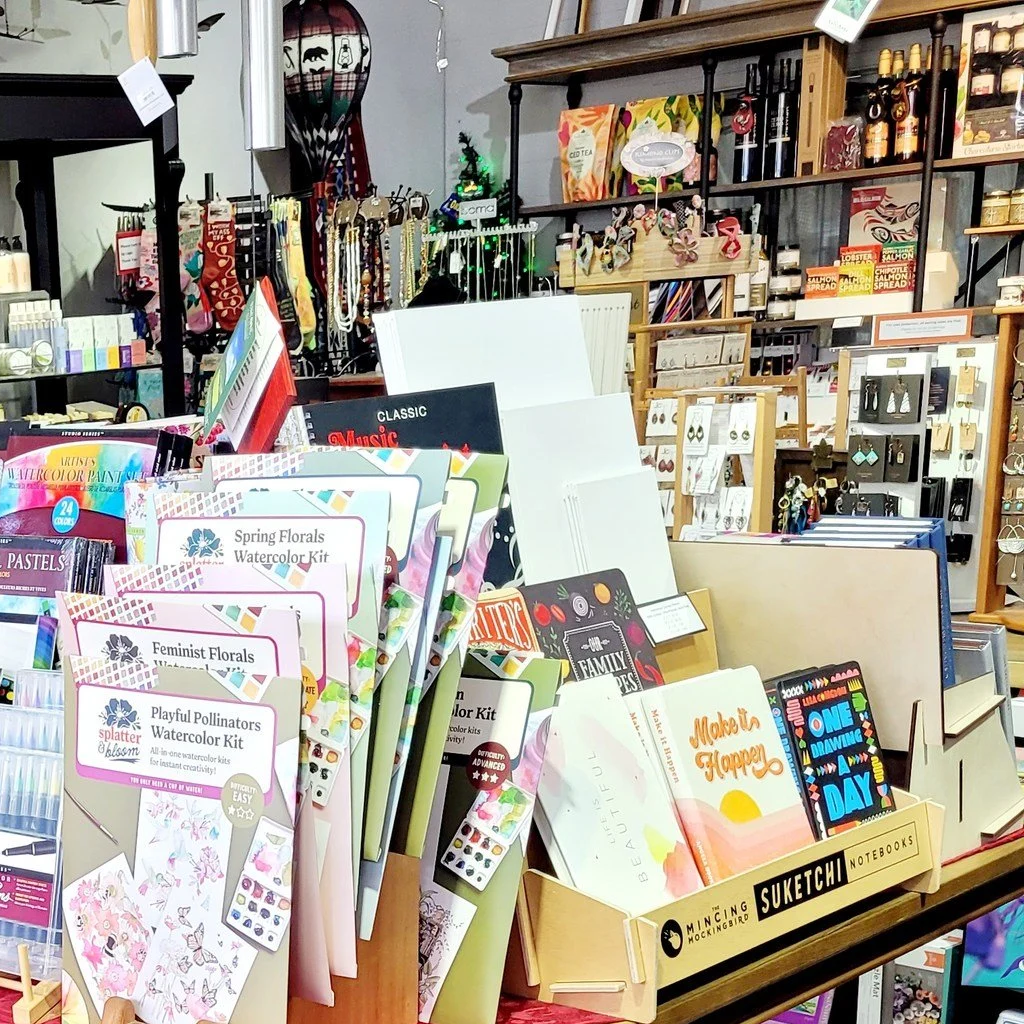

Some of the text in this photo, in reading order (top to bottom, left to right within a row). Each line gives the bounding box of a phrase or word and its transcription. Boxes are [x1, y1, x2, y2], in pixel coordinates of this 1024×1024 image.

[580, 149, 593, 157] TEA
[841, 253, 872, 261] LOBSTER
[882, 253, 914, 262] SALMON
[875, 266, 908, 274] CHIPOTLE
[875, 274, 909, 282] SALMON
[807, 282, 837, 291] SPREAD
[808, 276, 836, 284] SALMON
[839, 283, 872, 292] SPREAD
[874, 280, 908, 290] SPREAD
[377, 405, 427, 422] CLASSIC
[328, 425, 399, 448] Music
[7, 468, 122, 483] WATERCOLOR PAINT
[61, 500, 74, 516] 24
[234, 528, 325, 546] Spring Florals
[7, 553, 66, 572] PASTELS
[234, 549, 305, 564] Watercolor
[308, 549, 330, 564] Kit
[152, 641, 255, 664] Feminist Florals
[577, 651, 627, 679] FAMILY
[477, 700, 496, 721] Kit
[151, 706, 261, 732] Playful Pollinators
[808, 702, 854, 738] ONE
[98, 728, 142, 744] splatter
[151, 725, 244, 750] Watercolor Kit
[467, 726, 480, 735] kits
[104, 743, 140, 758] bloom
[810, 726, 863, 760] DRAWING
[182, 751, 231, 765] watercolor kits
[477, 750, 506, 760] DIFFICULTY:
[694, 742, 783, 782] Happen
[159, 759, 217, 775] instant creativity!
[472, 758, 506, 771] ADVANCED
[838, 755, 851, 778] A
[232, 791, 253, 805] EASY
[823, 771, 874, 822] DAY
[850, 835, 914, 870] NOTEBOOKS
[760, 857, 843, 914] SUKETCHI
[686, 900, 748, 934] MINCING
[688, 913, 750, 945] MOCKINGBIRD
